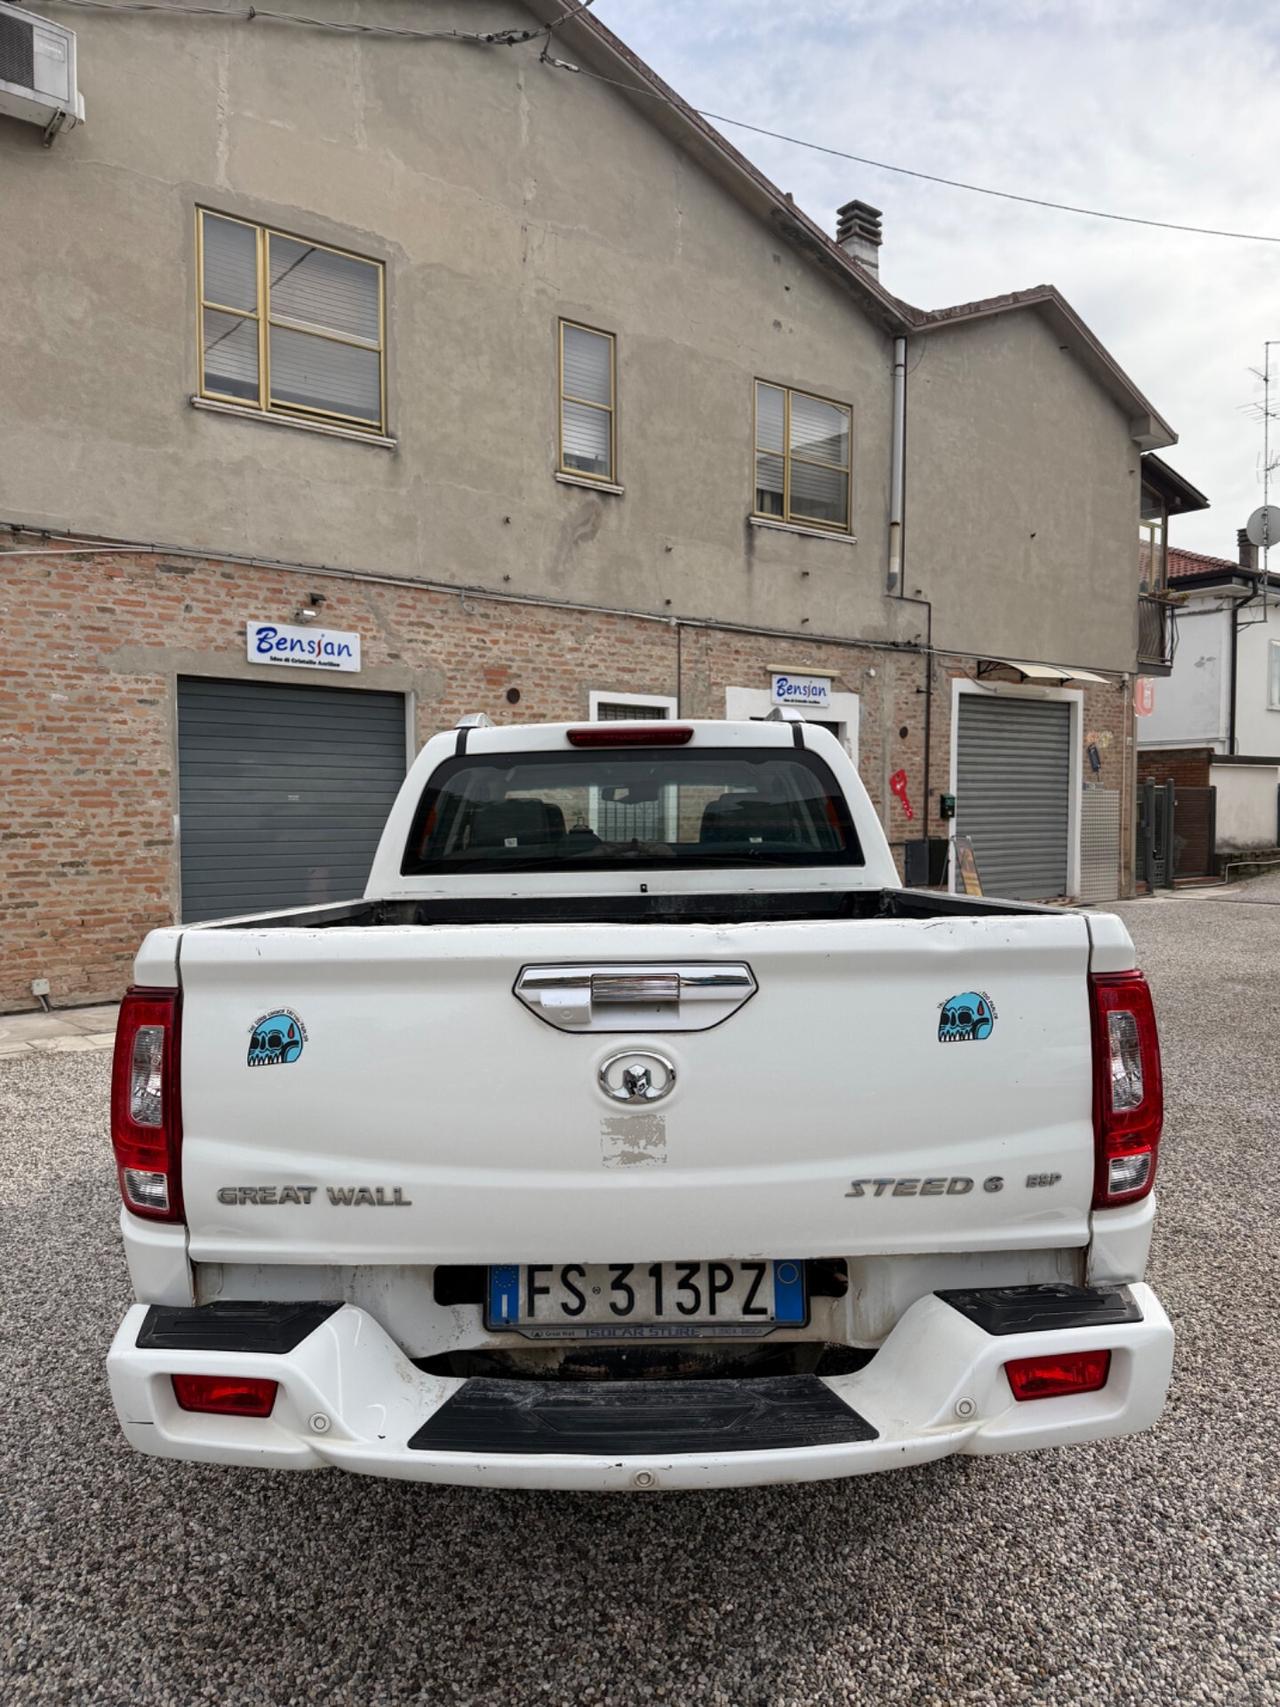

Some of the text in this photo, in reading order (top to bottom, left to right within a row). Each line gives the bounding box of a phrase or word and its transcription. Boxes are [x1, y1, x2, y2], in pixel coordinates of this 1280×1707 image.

[217, 1186, 413, 1206] GREAT WALL
[845, 1176, 1004, 1198] STEED 6
